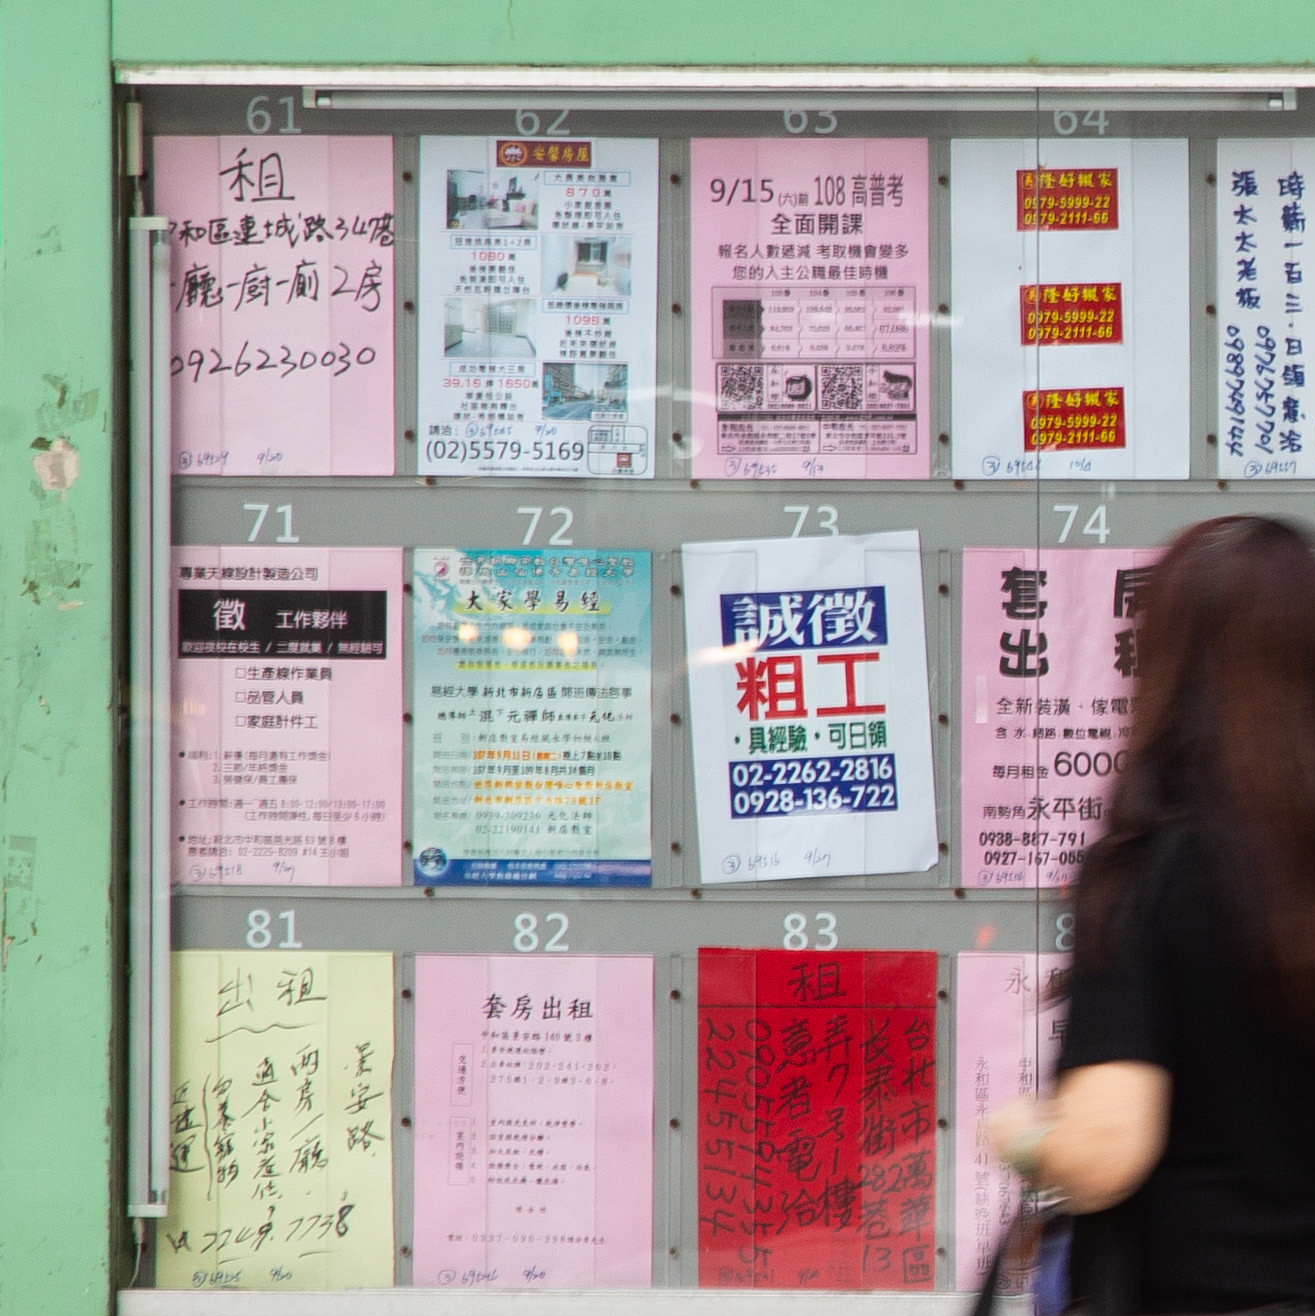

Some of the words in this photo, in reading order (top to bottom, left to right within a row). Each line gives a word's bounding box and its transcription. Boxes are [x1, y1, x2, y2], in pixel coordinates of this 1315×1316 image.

[246, 97, 302, 133] 61
[515, 108, 571, 135] 62
[784, 109, 838, 133] 63
[1054, 109, 1109, 134] 64
[221, 147, 295, 202] 租
[710, 177, 774, 206] 9/15
[814, 176, 846, 206] 108
[852, 173, 904, 208] 高普考
[771, 213, 864, 236] 全面開課
[717, 244, 811, 259] 報名人數遞減
[816, 244, 909, 259] 考取機會變多
[732, 265, 888, 281] 您的入主公職最佳時機
[426, 440, 584, 463] (02)5579-5169
[242, 504, 300, 543] 71
[516, 506, 575, 546] 72
[783, 505, 839, 539] 73
[1052, 505, 1111, 544] 74
[179, 566, 319, 581] 專業天線設計製造公司
[213, 598, 246, 631] 徵
[275, 610, 349, 630] 工作夥伴
[466, 590, 600, 612] 大家學易經
[731, 590, 877, 646] 誠徵
[246, 667, 333, 681] 生產線作業員
[735, 652, 886, 721] 粗工
[246, 691, 304, 705] 品管人員
[246, 715, 318, 729] 家庭計件工
[732, 760, 894, 788] 02-2262-2816
[992, 765, 1049, 779] 每月租金
[733, 785, 895, 813] 0928-136-722
[245, 910, 303, 949] 81
[512, 912, 571, 952] 82
[782, 911, 838, 951] 83
[792, 961, 847, 1000] 租
[481, 993, 593, 1021] 套房出租
[899, 1017, 934, 1284] 台北市萬華區
